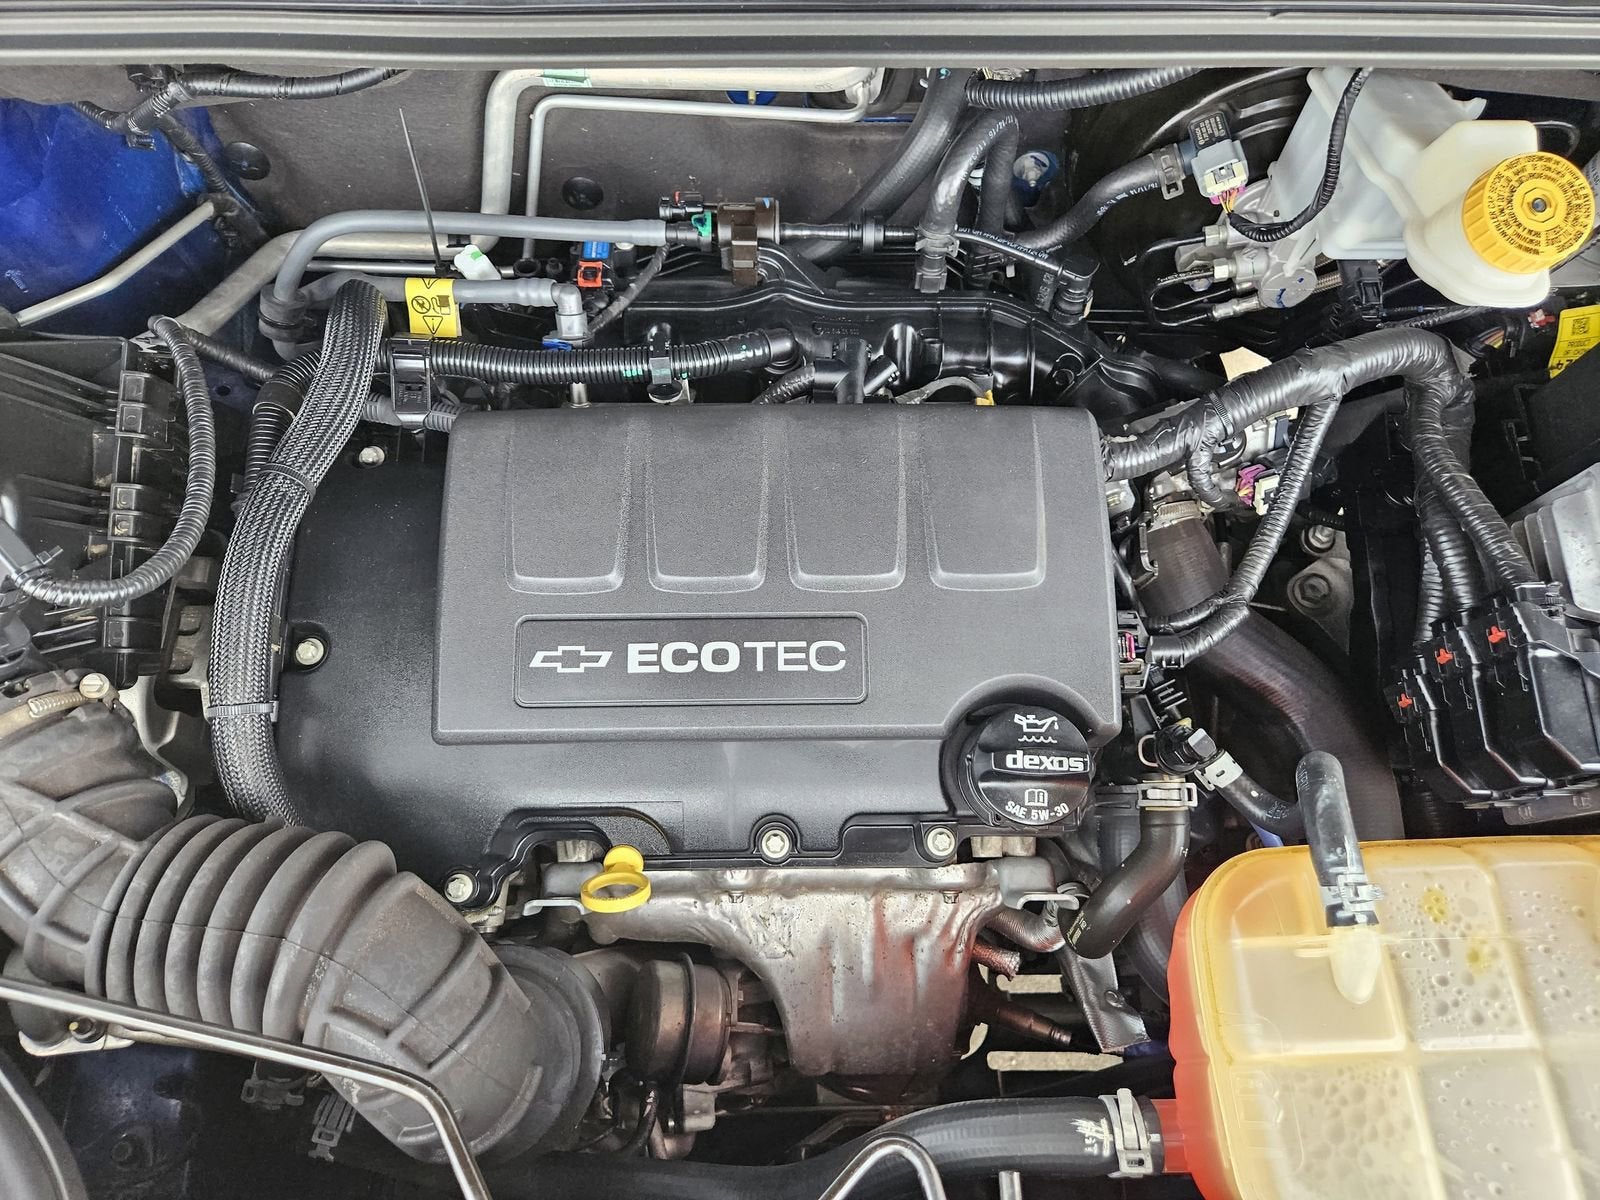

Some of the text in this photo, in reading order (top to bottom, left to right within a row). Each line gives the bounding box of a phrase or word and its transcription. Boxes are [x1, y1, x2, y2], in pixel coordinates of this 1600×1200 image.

[628, 641, 846, 673] ECOTEC
[1006, 750, 1084, 772] dexos
[1005, 801, 1070, 821] SAE 5W-30
